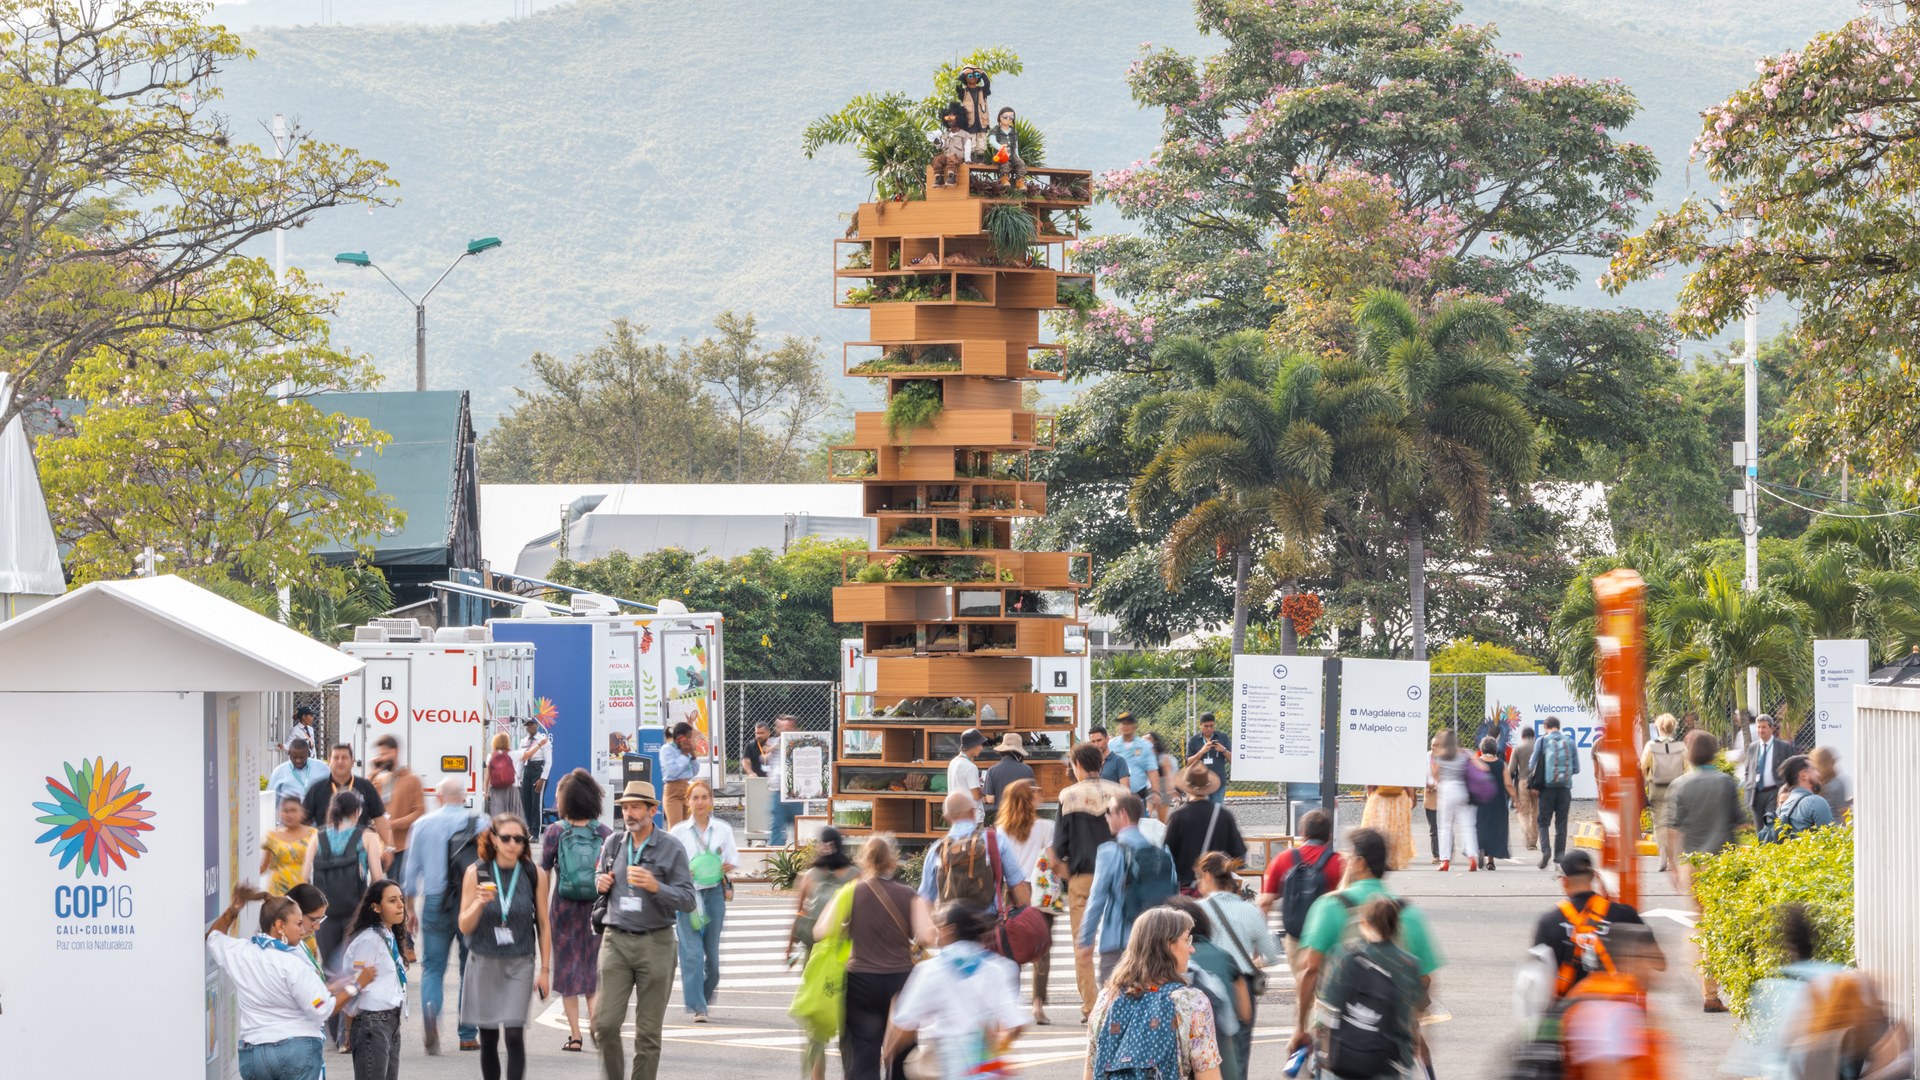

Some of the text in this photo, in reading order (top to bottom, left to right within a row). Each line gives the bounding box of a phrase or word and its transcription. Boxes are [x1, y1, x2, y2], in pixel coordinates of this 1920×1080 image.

[622, 688, 634, 697] LA
[1359, 708, 1406, 719] Magdalena
[1533, 704, 1587, 713] Welcome to
[412, 709, 481, 723] VEOLIA
[1358, 723, 1408, 733] Malpelo CG1
[55, 885, 133, 918] COP16
[56, 940, 133, 950] Paz con la Naturaleza
